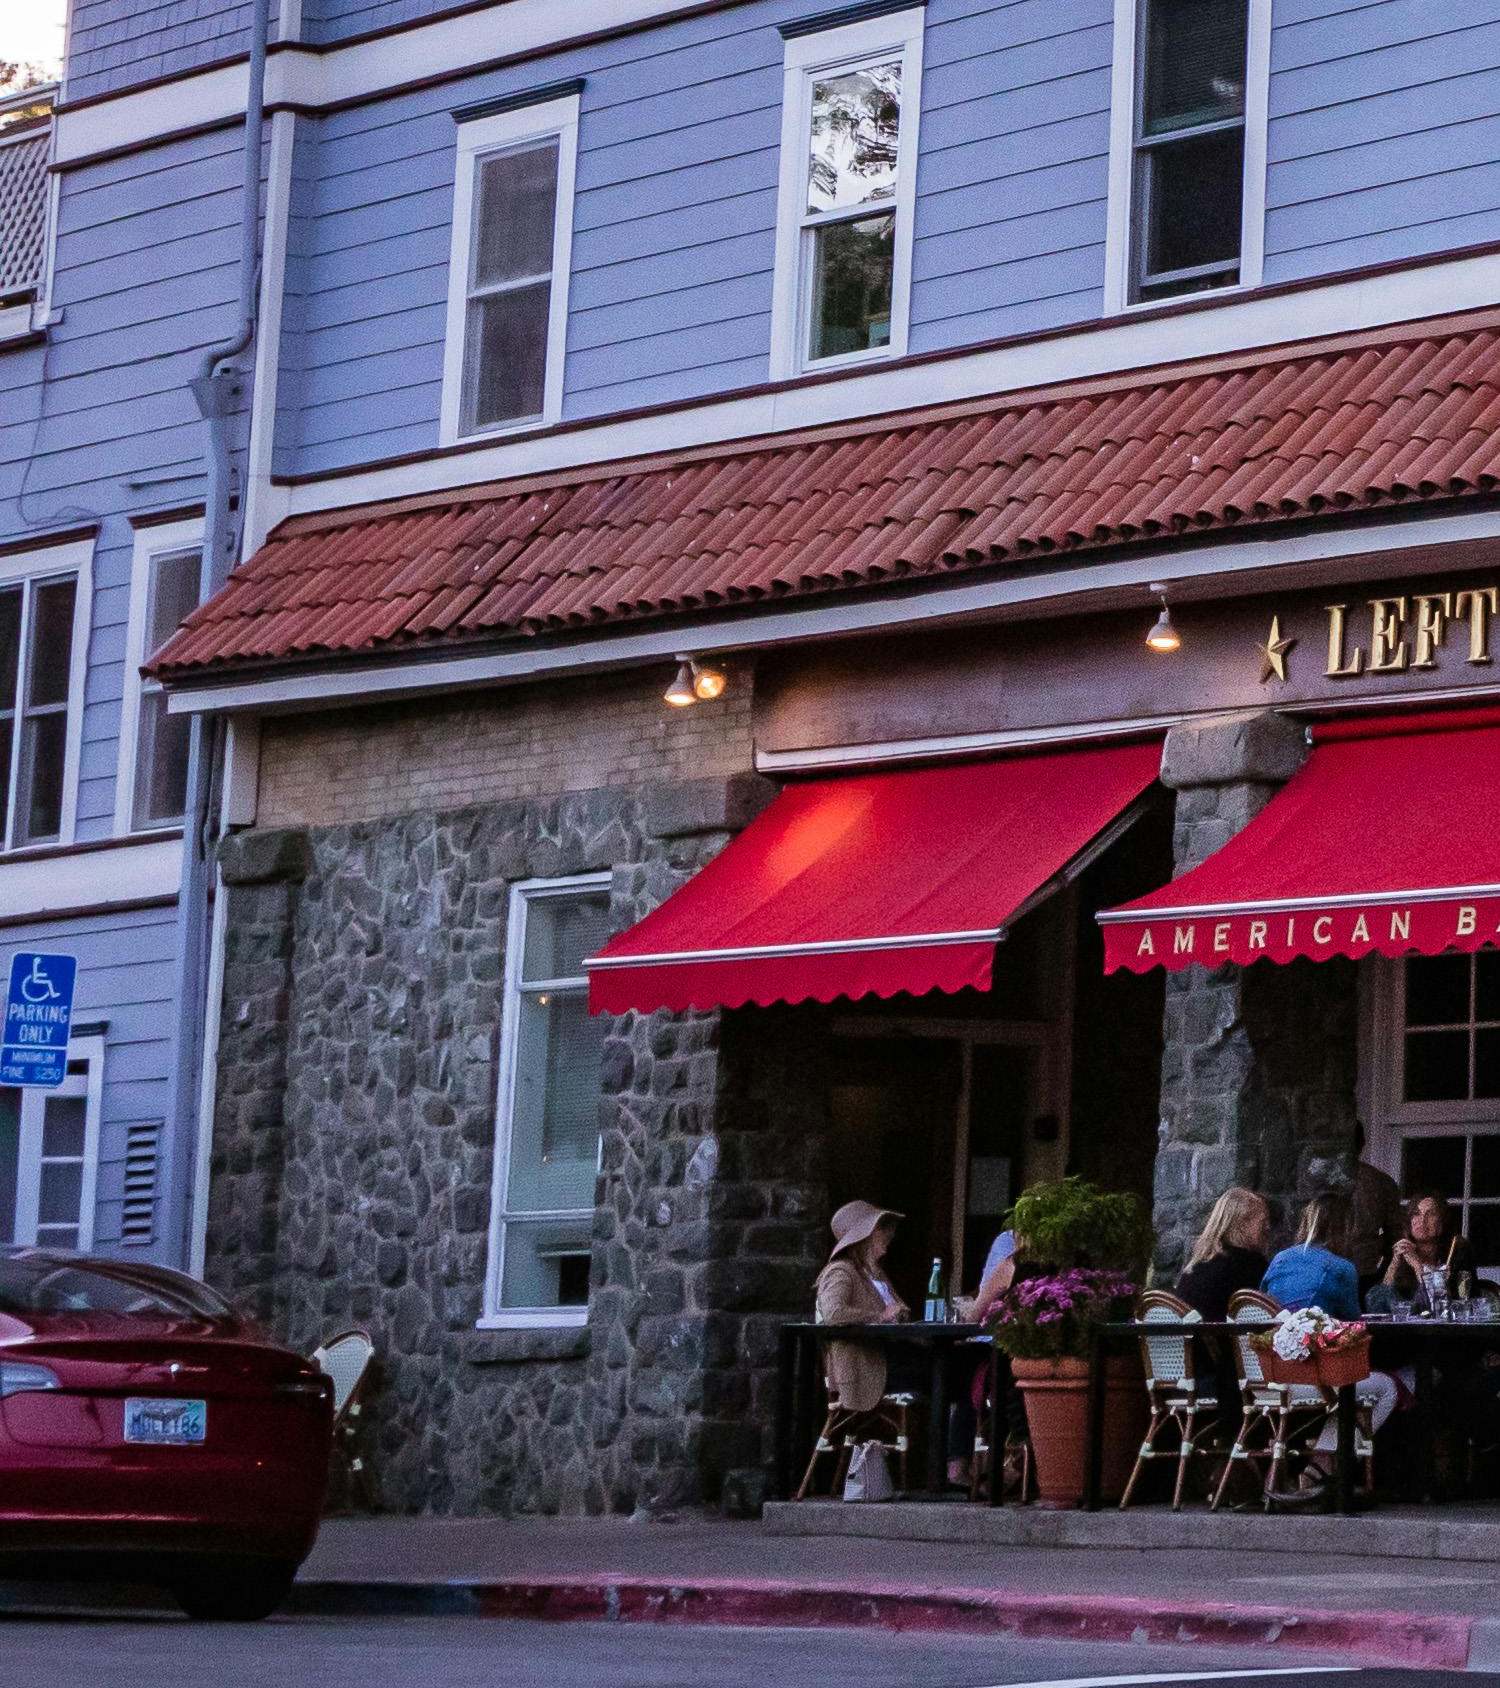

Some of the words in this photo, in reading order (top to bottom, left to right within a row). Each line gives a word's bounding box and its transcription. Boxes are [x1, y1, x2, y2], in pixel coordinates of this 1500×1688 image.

[1322, 587, 1499, 678] LEFT
[1136, 910, 1411, 956] AMERICAN
[8, 1002, 69, 1024] PARKING
[19, 1024, 54, 1043] ONLY
[12, 1050, 56, 1063] MINIMUM
[2, 1066, 25, 1079] FINE
[34, 1066, 62, 1080] $250
